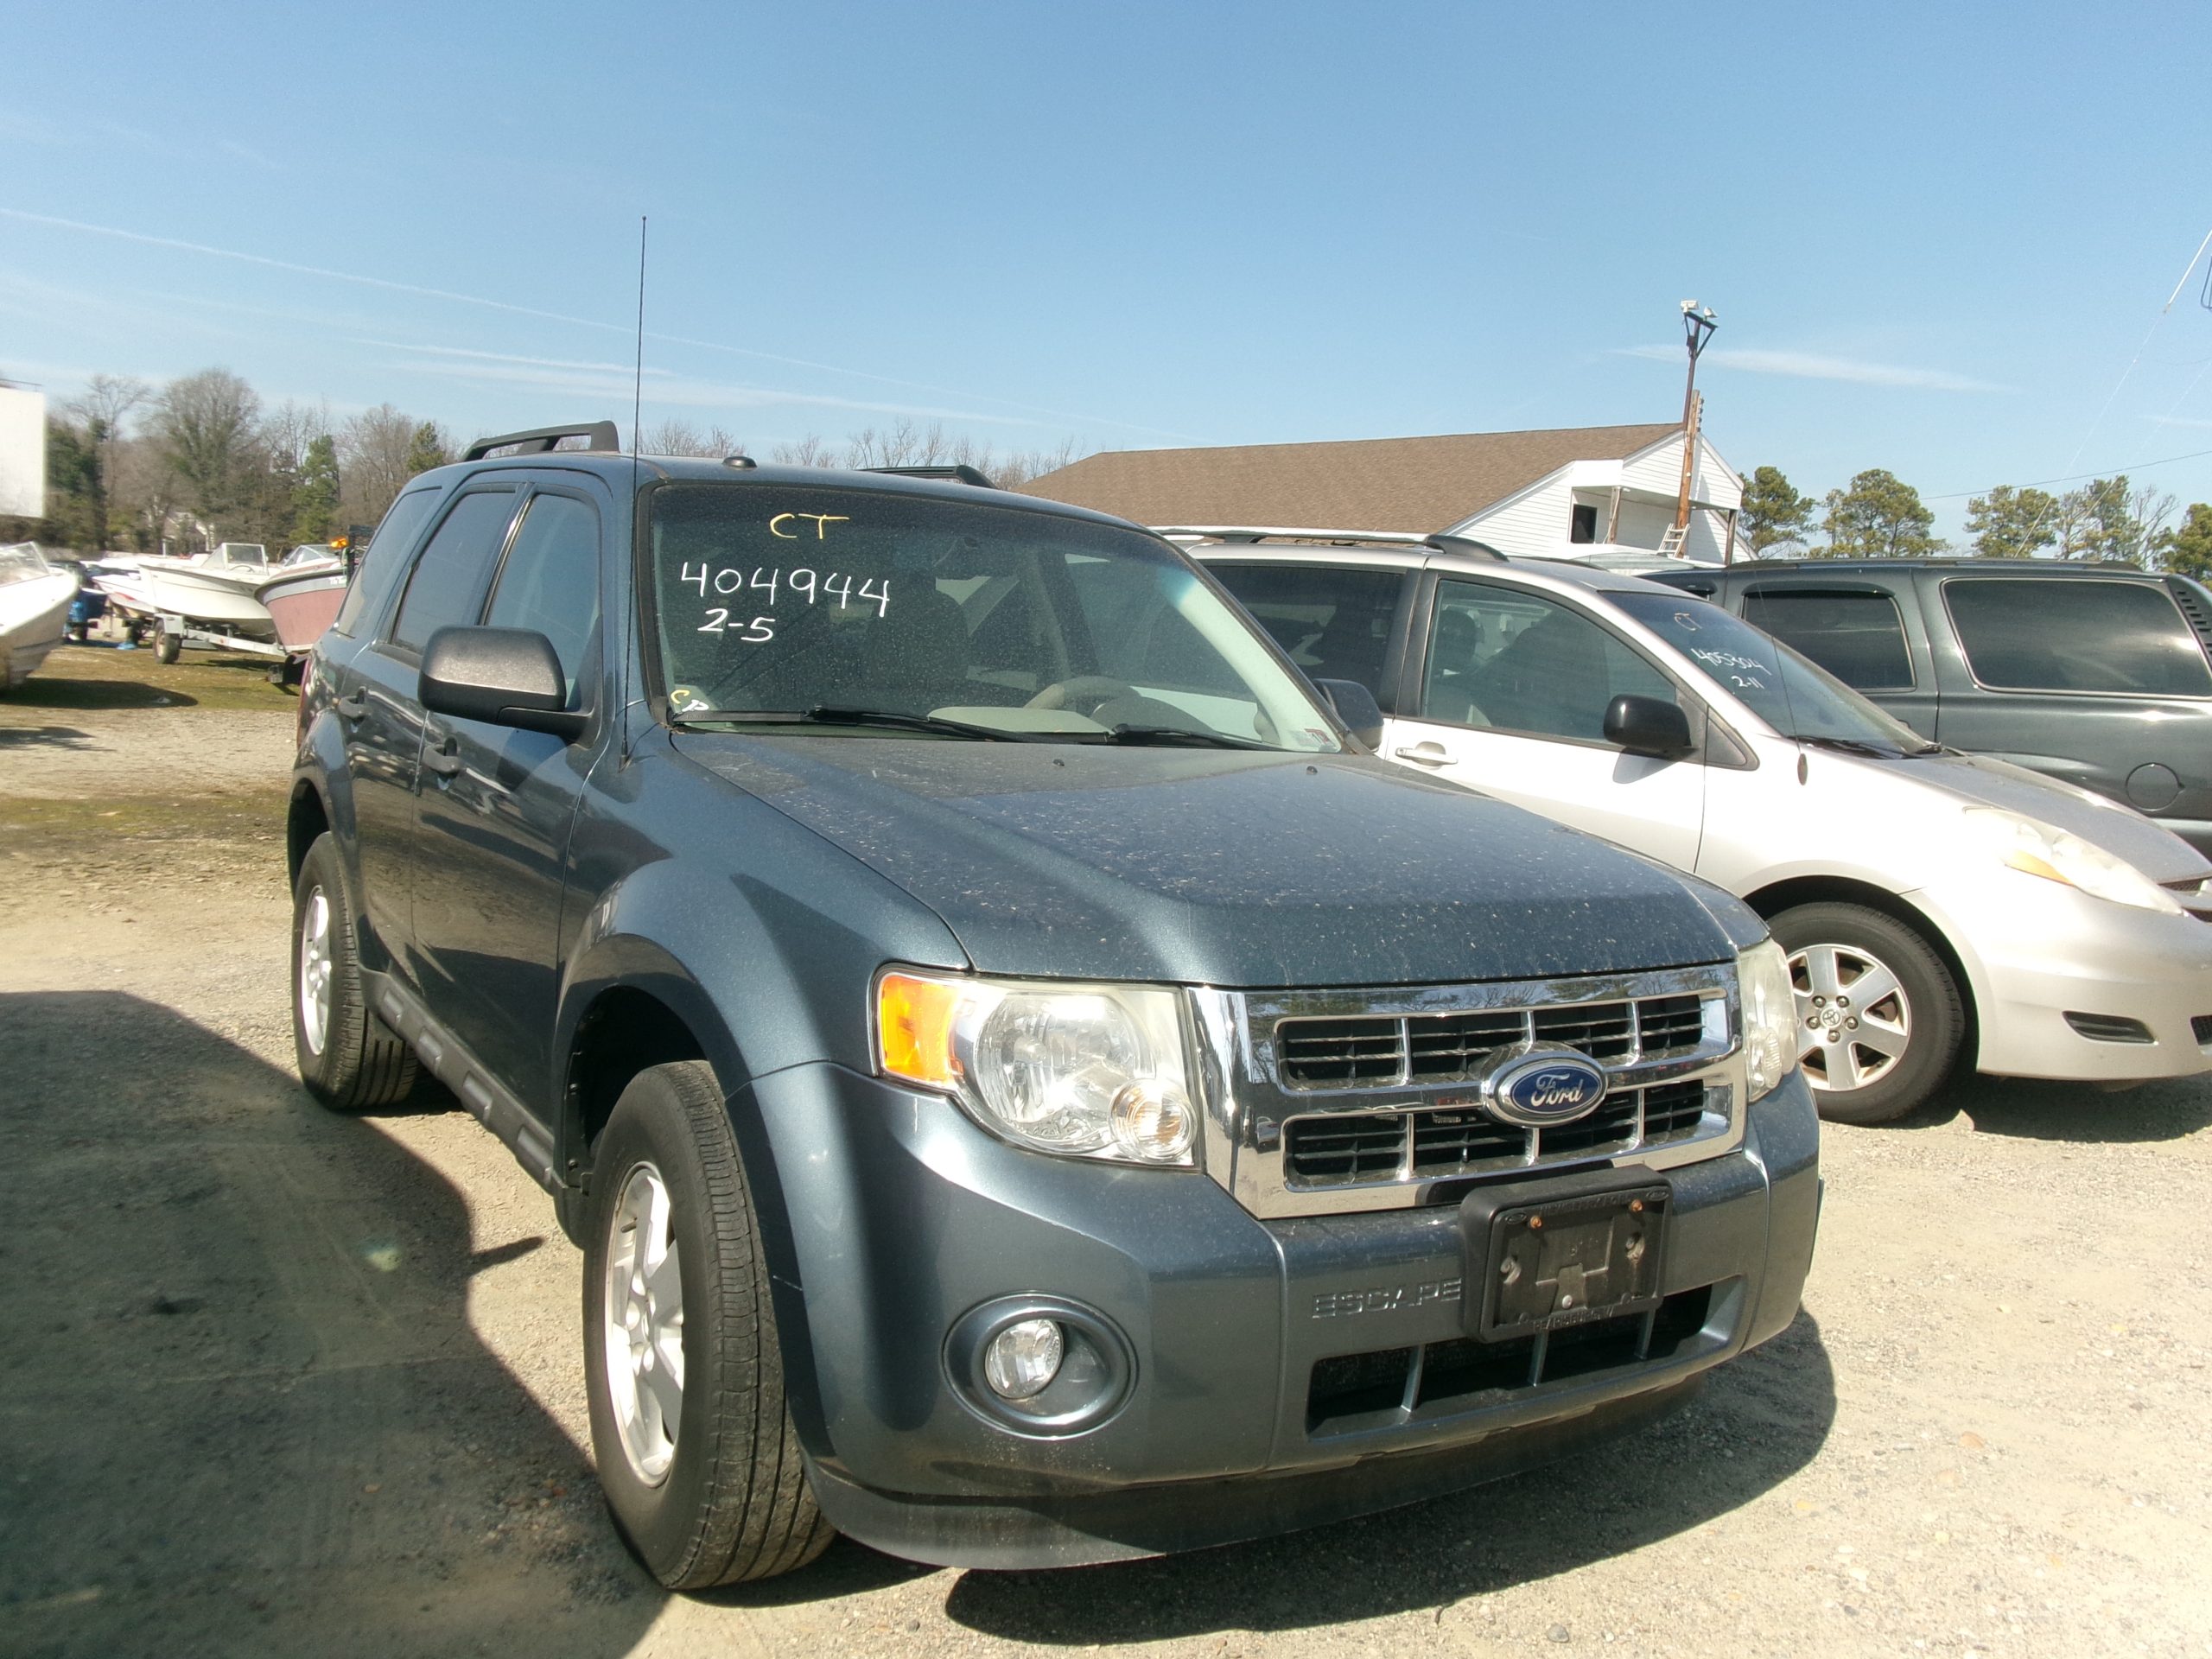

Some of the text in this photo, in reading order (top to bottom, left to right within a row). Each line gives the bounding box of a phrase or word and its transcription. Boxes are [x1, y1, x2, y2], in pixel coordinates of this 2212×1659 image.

[769, 512, 850, 540] CT
[681, 562, 891, 619] 404944
[696, 607, 777, 643] 2-5
[1529, 1072, 1584, 1108] Ford
[1312, 1277, 1462, 1319] ESCAPE
